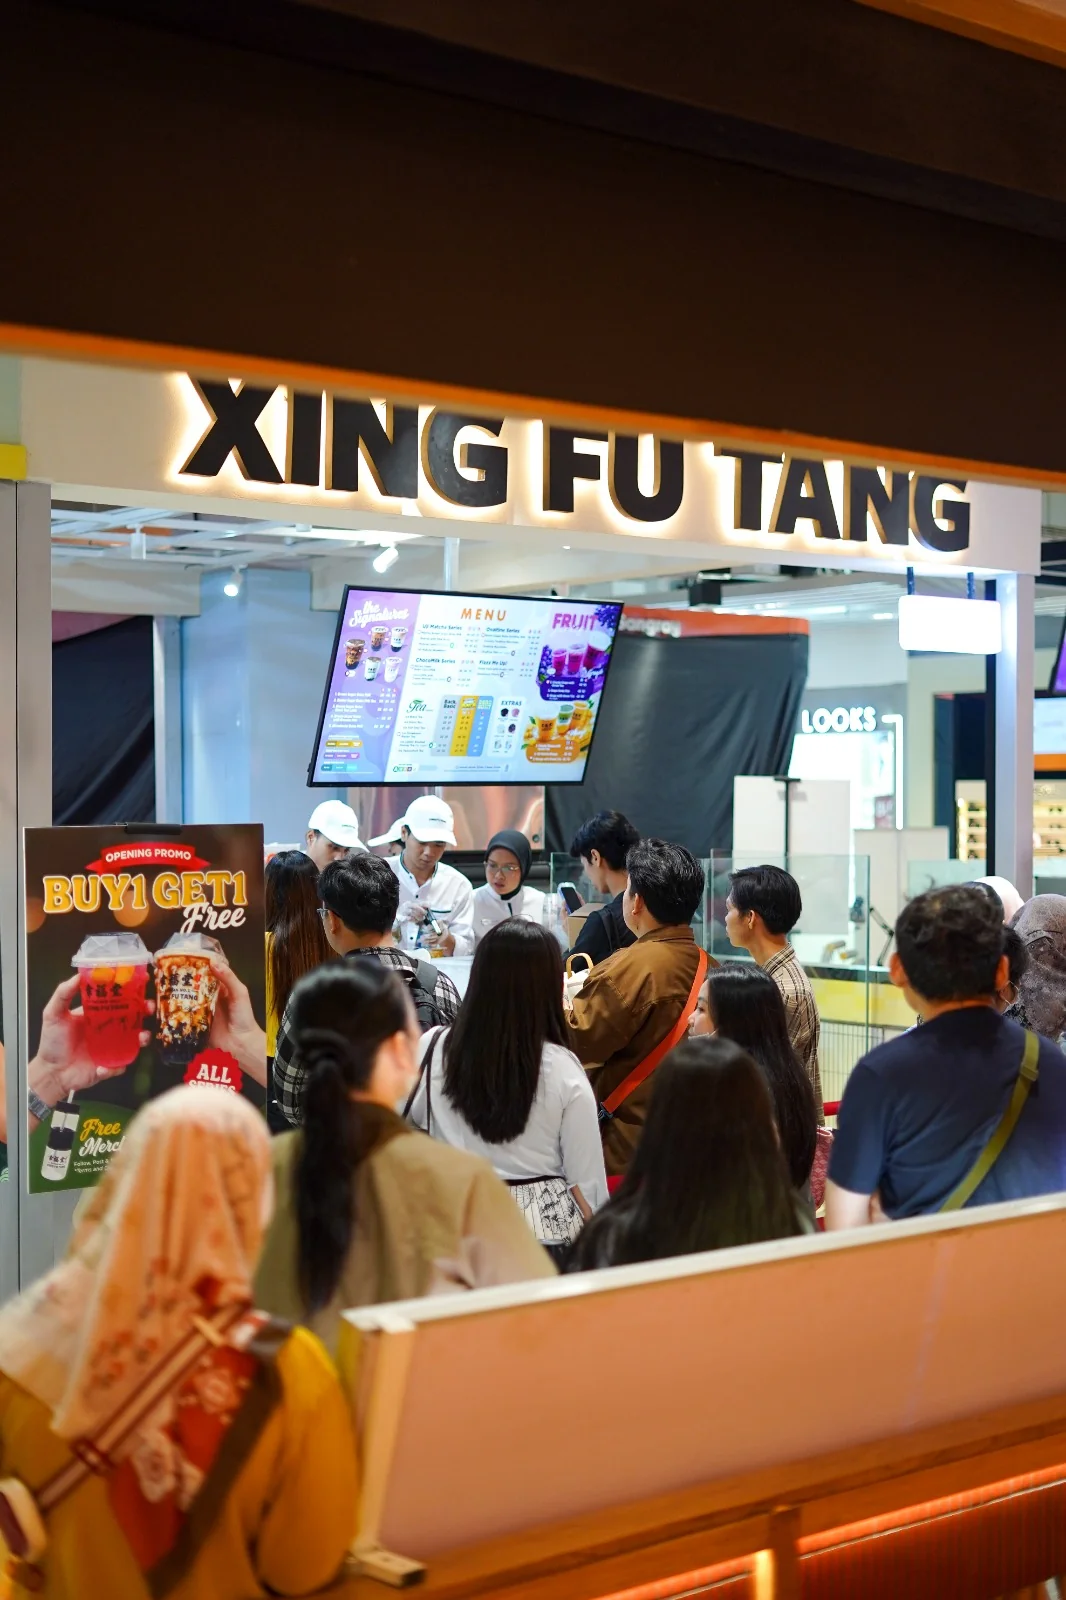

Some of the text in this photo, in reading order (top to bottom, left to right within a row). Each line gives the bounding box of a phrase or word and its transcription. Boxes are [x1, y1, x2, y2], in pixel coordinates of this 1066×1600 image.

[178, 375, 970, 552] XING FU TANG
[363, 601, 380, 614] the
[461, 608, 506, 621] MENU
[552, 613, 598, 631] FRUIT
[801, 706, 876, 733] LOOKS
[105, 848, 192, 863] OPENING PROMO
[180, 902, 246, 934] Free
[196, 1063, 232, 1083] ALL
[79, 1118, 121, 1142] Free
